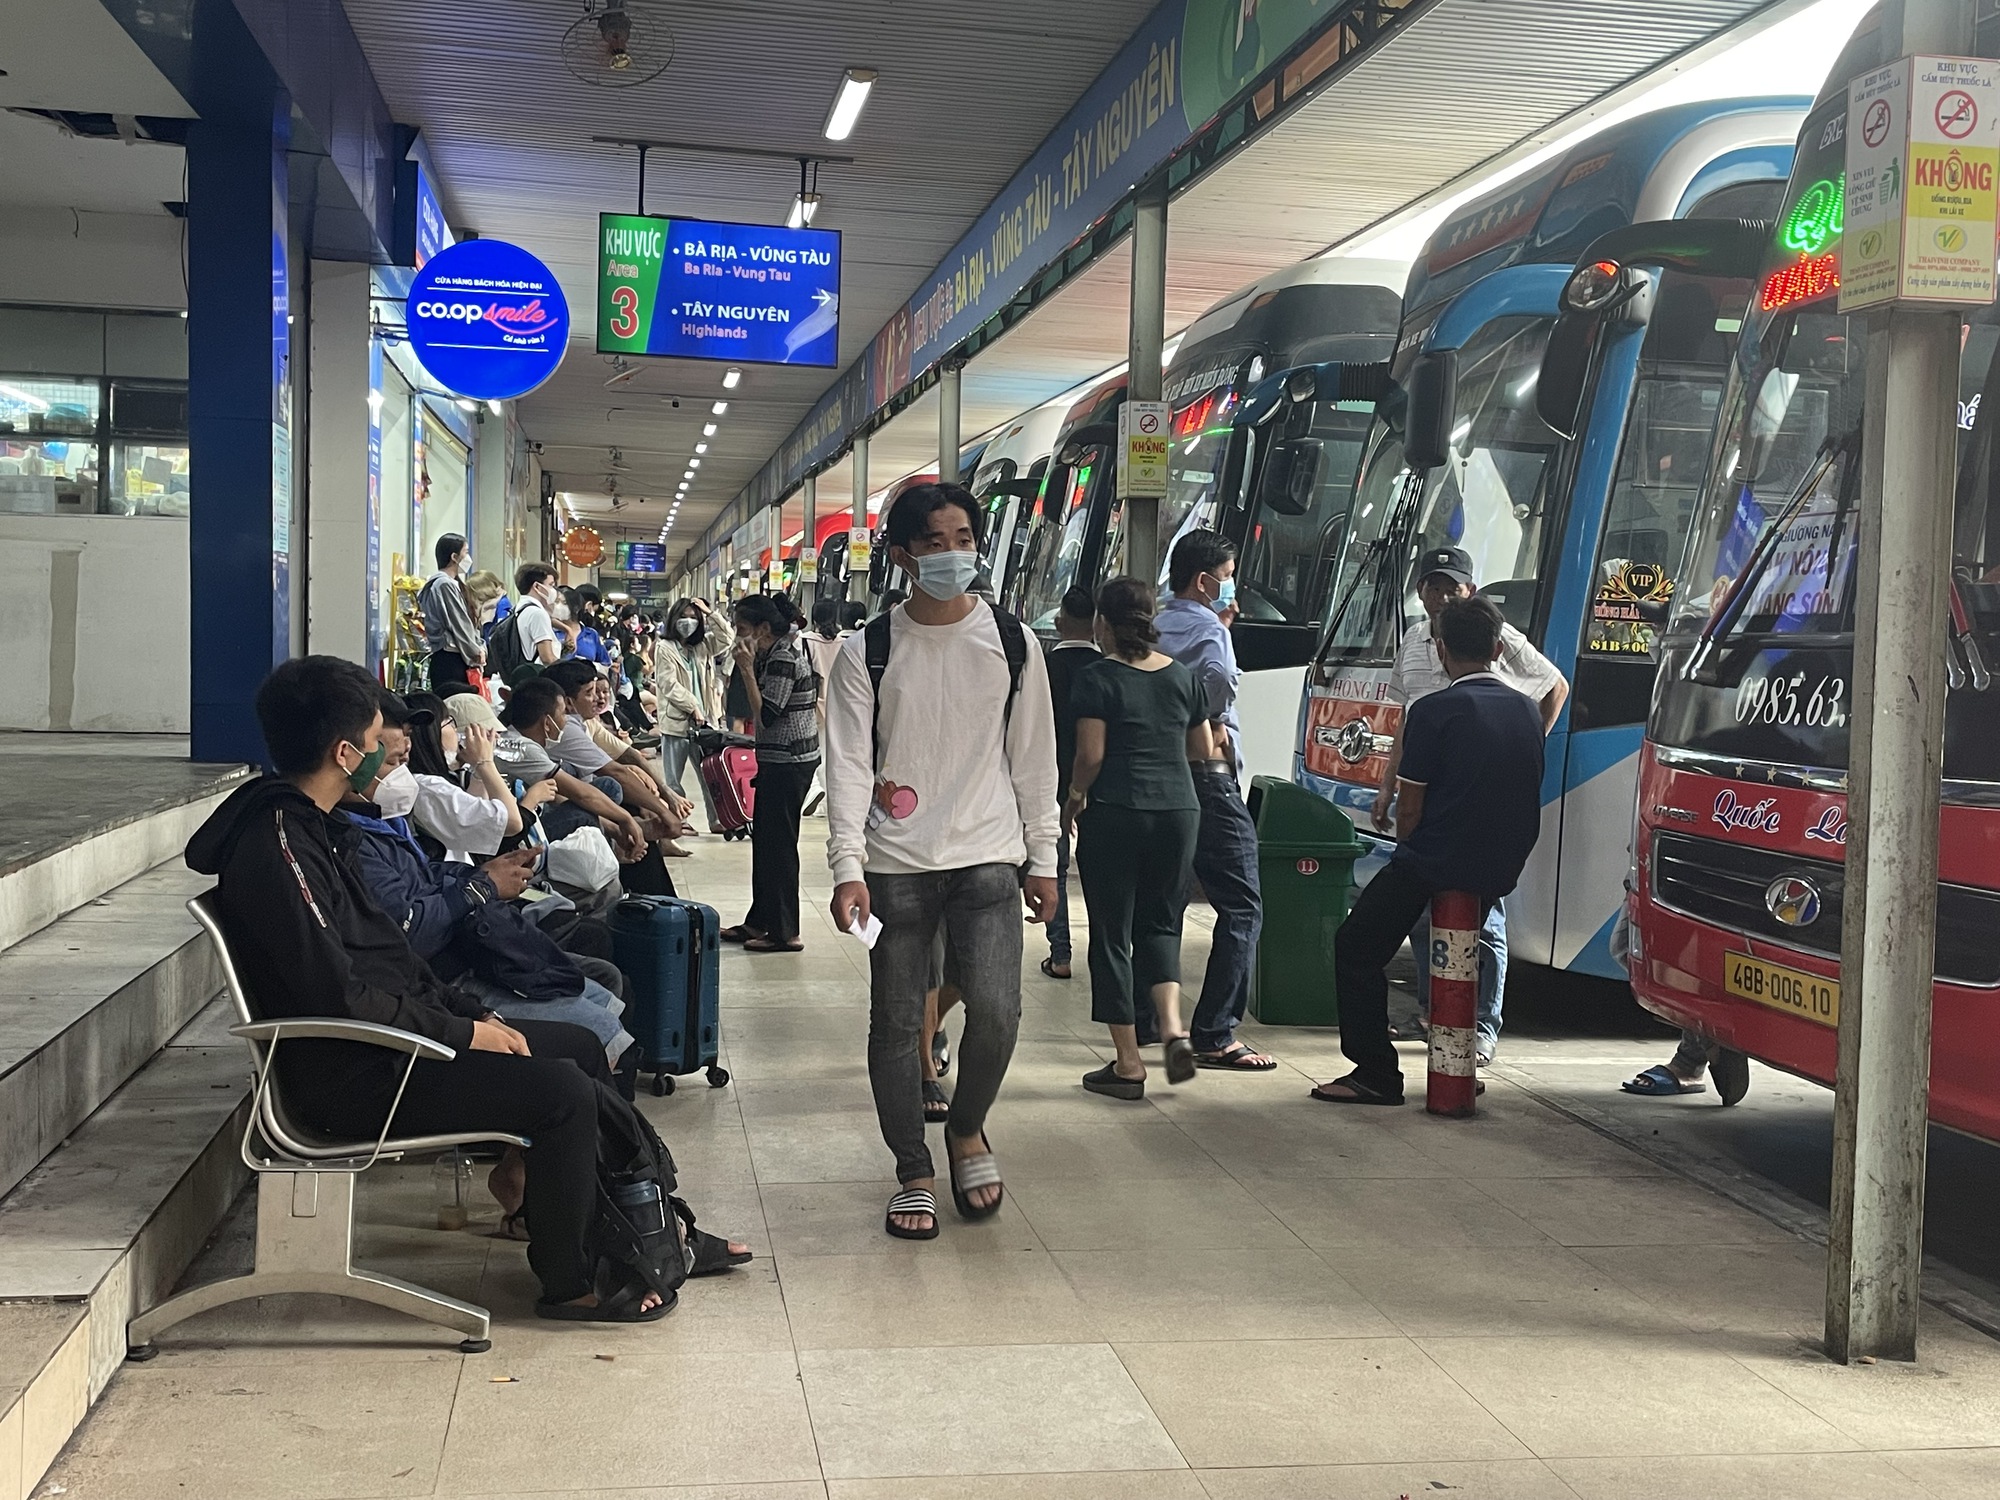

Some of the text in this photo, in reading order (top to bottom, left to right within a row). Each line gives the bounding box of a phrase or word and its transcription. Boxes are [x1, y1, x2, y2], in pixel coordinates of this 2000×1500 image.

[1937, 62, 1978, 76] KHU VỰC
[955, 255, 968, 315] BÀ
[969, 248, 986, 305] RỊA
[992, 205, 1023, 279] VŨNG
[1025, 173, 1051, 246] TÀU
[1062, 128, 1093, 210] TÂY
[1095, 37, 1175, 179] NGUYÊN
[1915, 148, 1993, 192] KHÔNG
[605, 228, 661, 266] KHU VỰC
[684, 241, 707, 259] BÀ
[712, 244, 738, 263] RỊA
[750, 246, 797, 263] VŨNG
[799, 248, 831, 266] TÀU
[606, 260, 639, 279] Area
[684, 262, 701, 275] Ba
[733, 265, 767, 283] Vung
[768, 267, 791, 282] Tau
[434, 276, 451, 285] CỬA
[452, 277, 473, 286] HÀNG
[474, 278, 494, 287] BÁCH
[610, 286, 640, 339] 3
[682, 301, 790, 323] TÂY NGUYÊN
[682, 323, 748, 340] Highlands
[1132, 437, 1165, 454] KHÔNG
[1781, 523, 1820, 543] GIƯỜNG
[1630, 574, 1653, 587] VIP
[1332, 673, 1371, 700] HỒNG
[1712, 788, 1781, 834] Quốc
[1300, 860, 1314, 872] 11
[1733, 962, 1831, 1016] 48B-006.10
